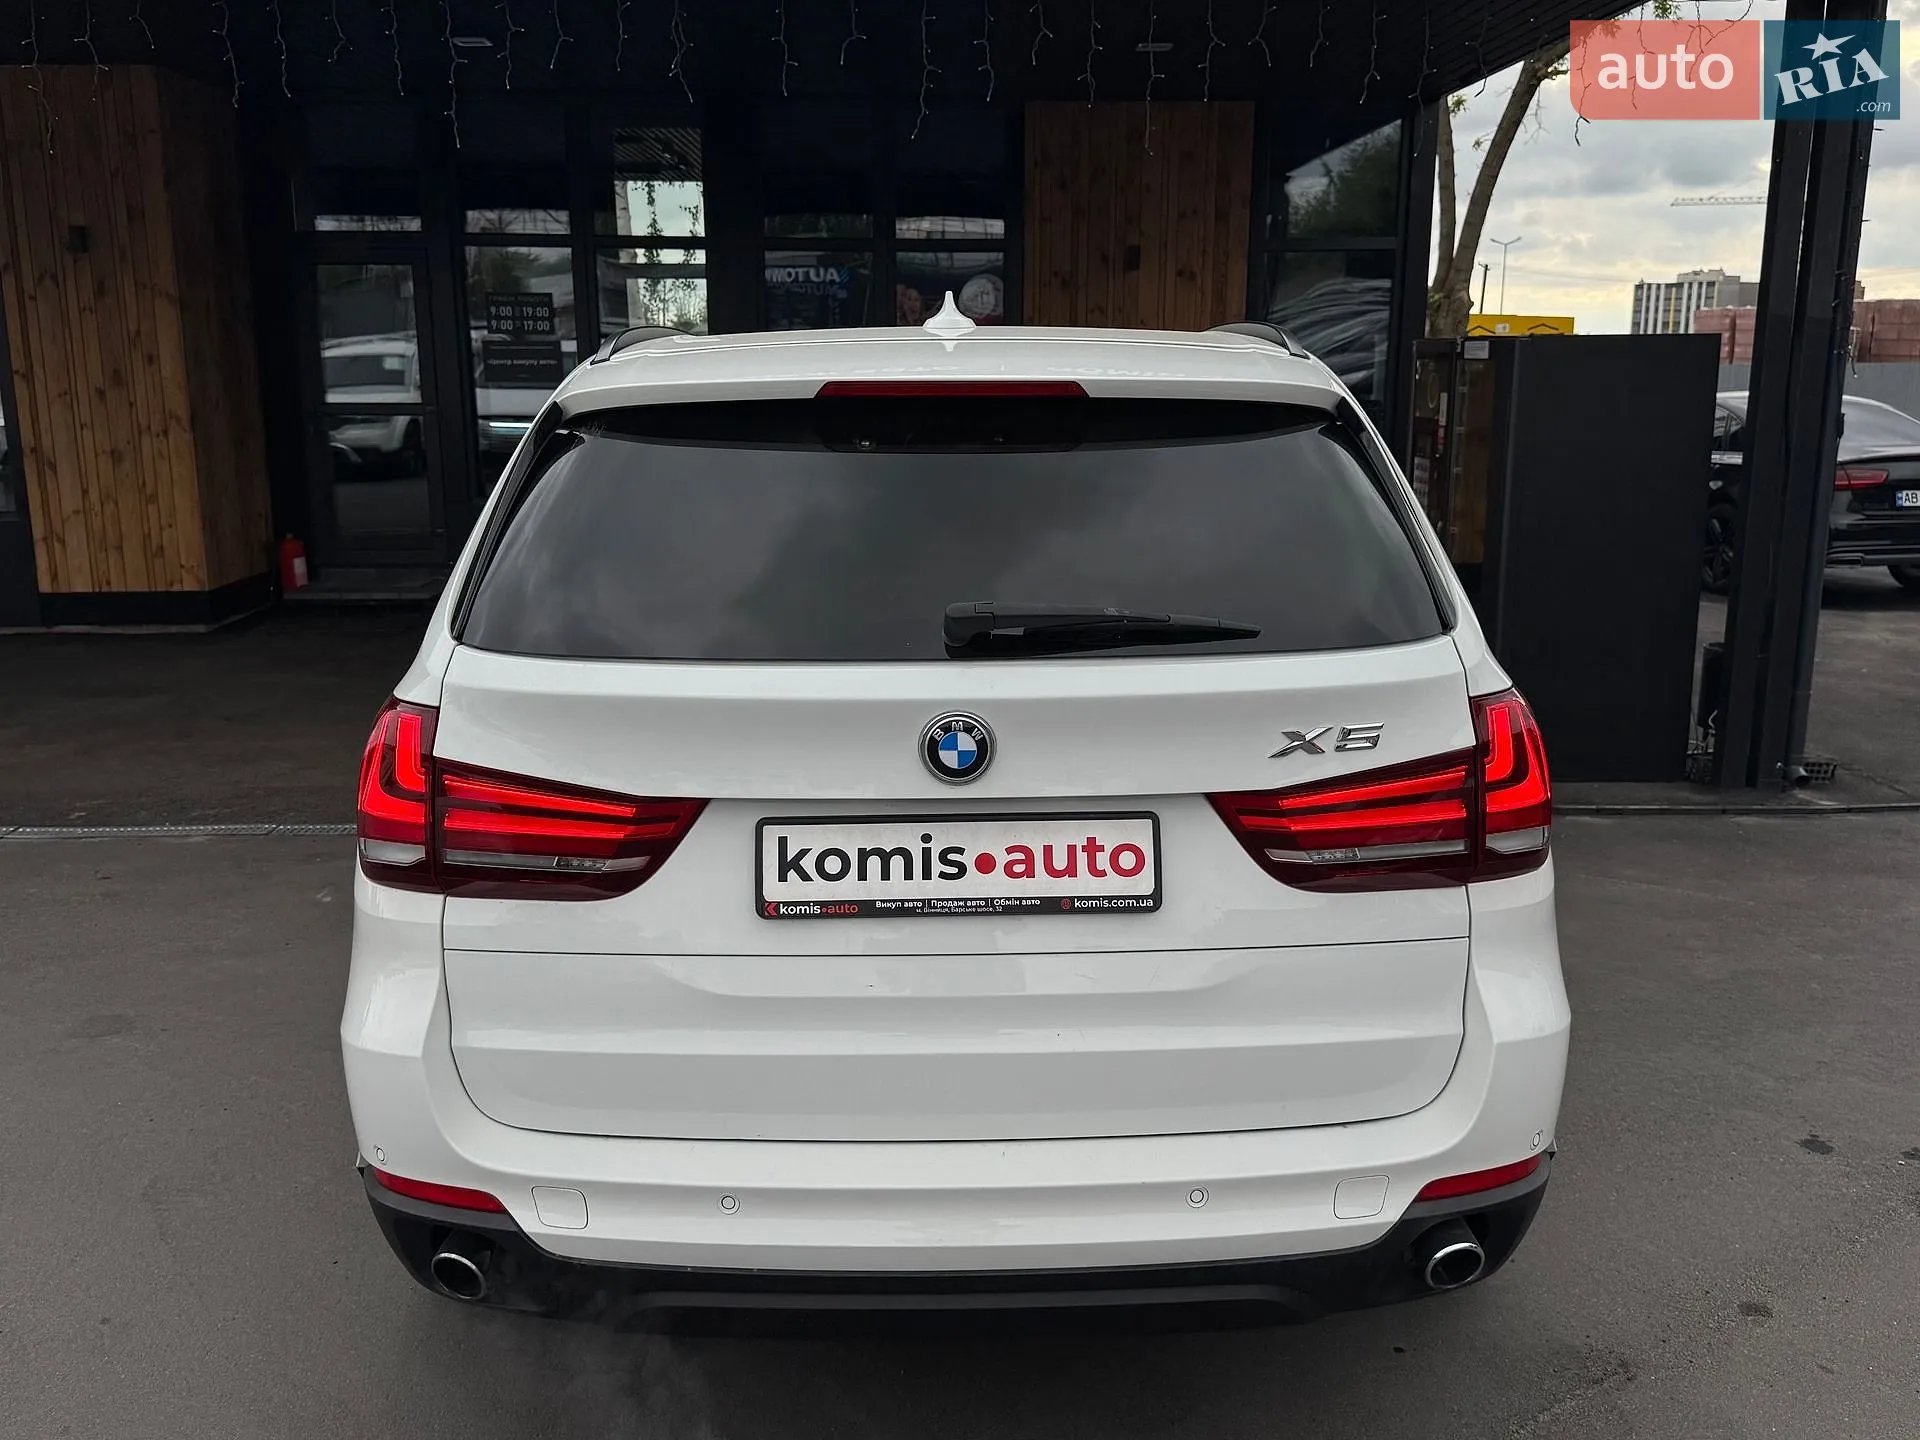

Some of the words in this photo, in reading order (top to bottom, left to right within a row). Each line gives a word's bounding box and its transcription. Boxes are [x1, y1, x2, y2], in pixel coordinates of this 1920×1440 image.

[490, 305, 513, 317] 9:00
[522, 306, 549, 318] 19:00
[491, 319, 513, 331] 9:00
[523, 320, 550, 331] 17:00
[932, 721, 984, 741] BMW
[1267, 721, 1385, 759] X5
[875, 901, 902, 909] Викуп
[931, 900, 965, 908] Продаж
[993, 898, 1020, 906] Обмін
[1074, 898, 1154, 908] komis.com.ua
